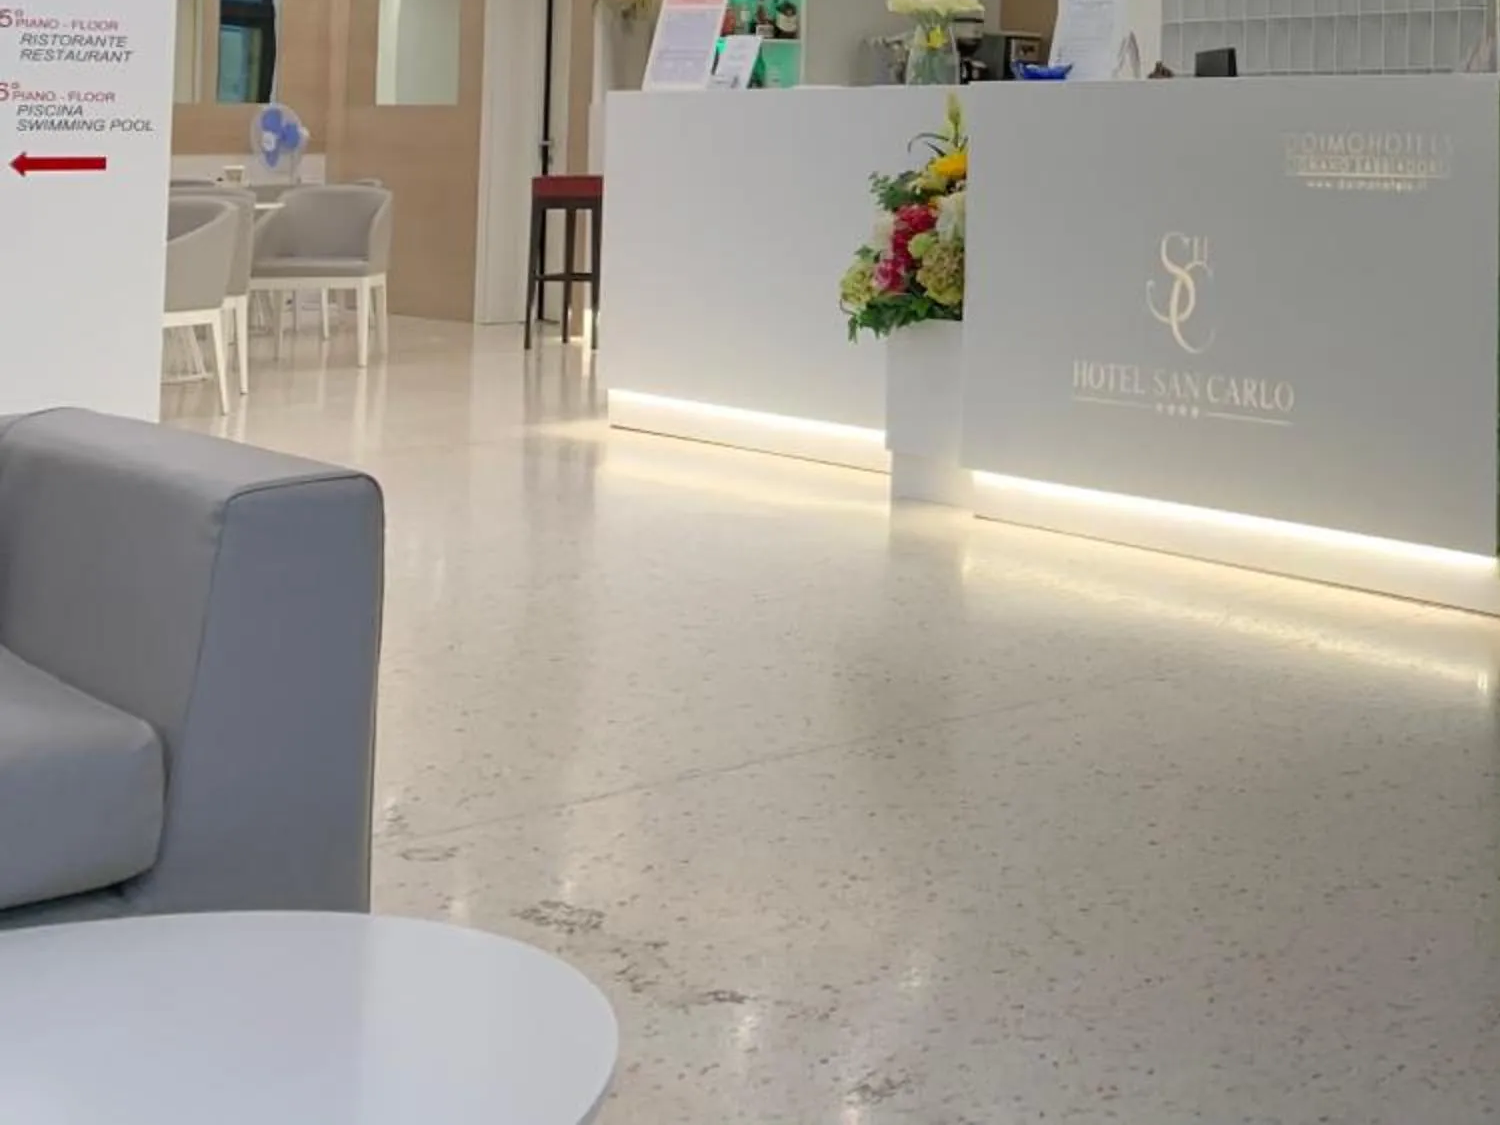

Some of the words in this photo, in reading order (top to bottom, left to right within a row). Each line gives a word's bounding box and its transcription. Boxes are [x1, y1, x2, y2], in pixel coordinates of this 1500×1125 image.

[15, 17, 60, 30] PIANO
[71, 19, 118, 31] FLOOR
[19, 32, 128, 48] RISTORANTE
[19, 48, 133, 63] RESTAURANT
[12, 90, 56, 102] PIANO
[67, 91, 116, 103] FLOOR
[16, 104, 83, 116] PISCINA
[16, 118, 105, 132] SWIMMING
[109, 119, 153, 132] POOL
[1072, 359, 1146, 395] HOTEL
[1152, 370, 1200, 400] SAN
[1206, 375, 1295, 412] CARLO
